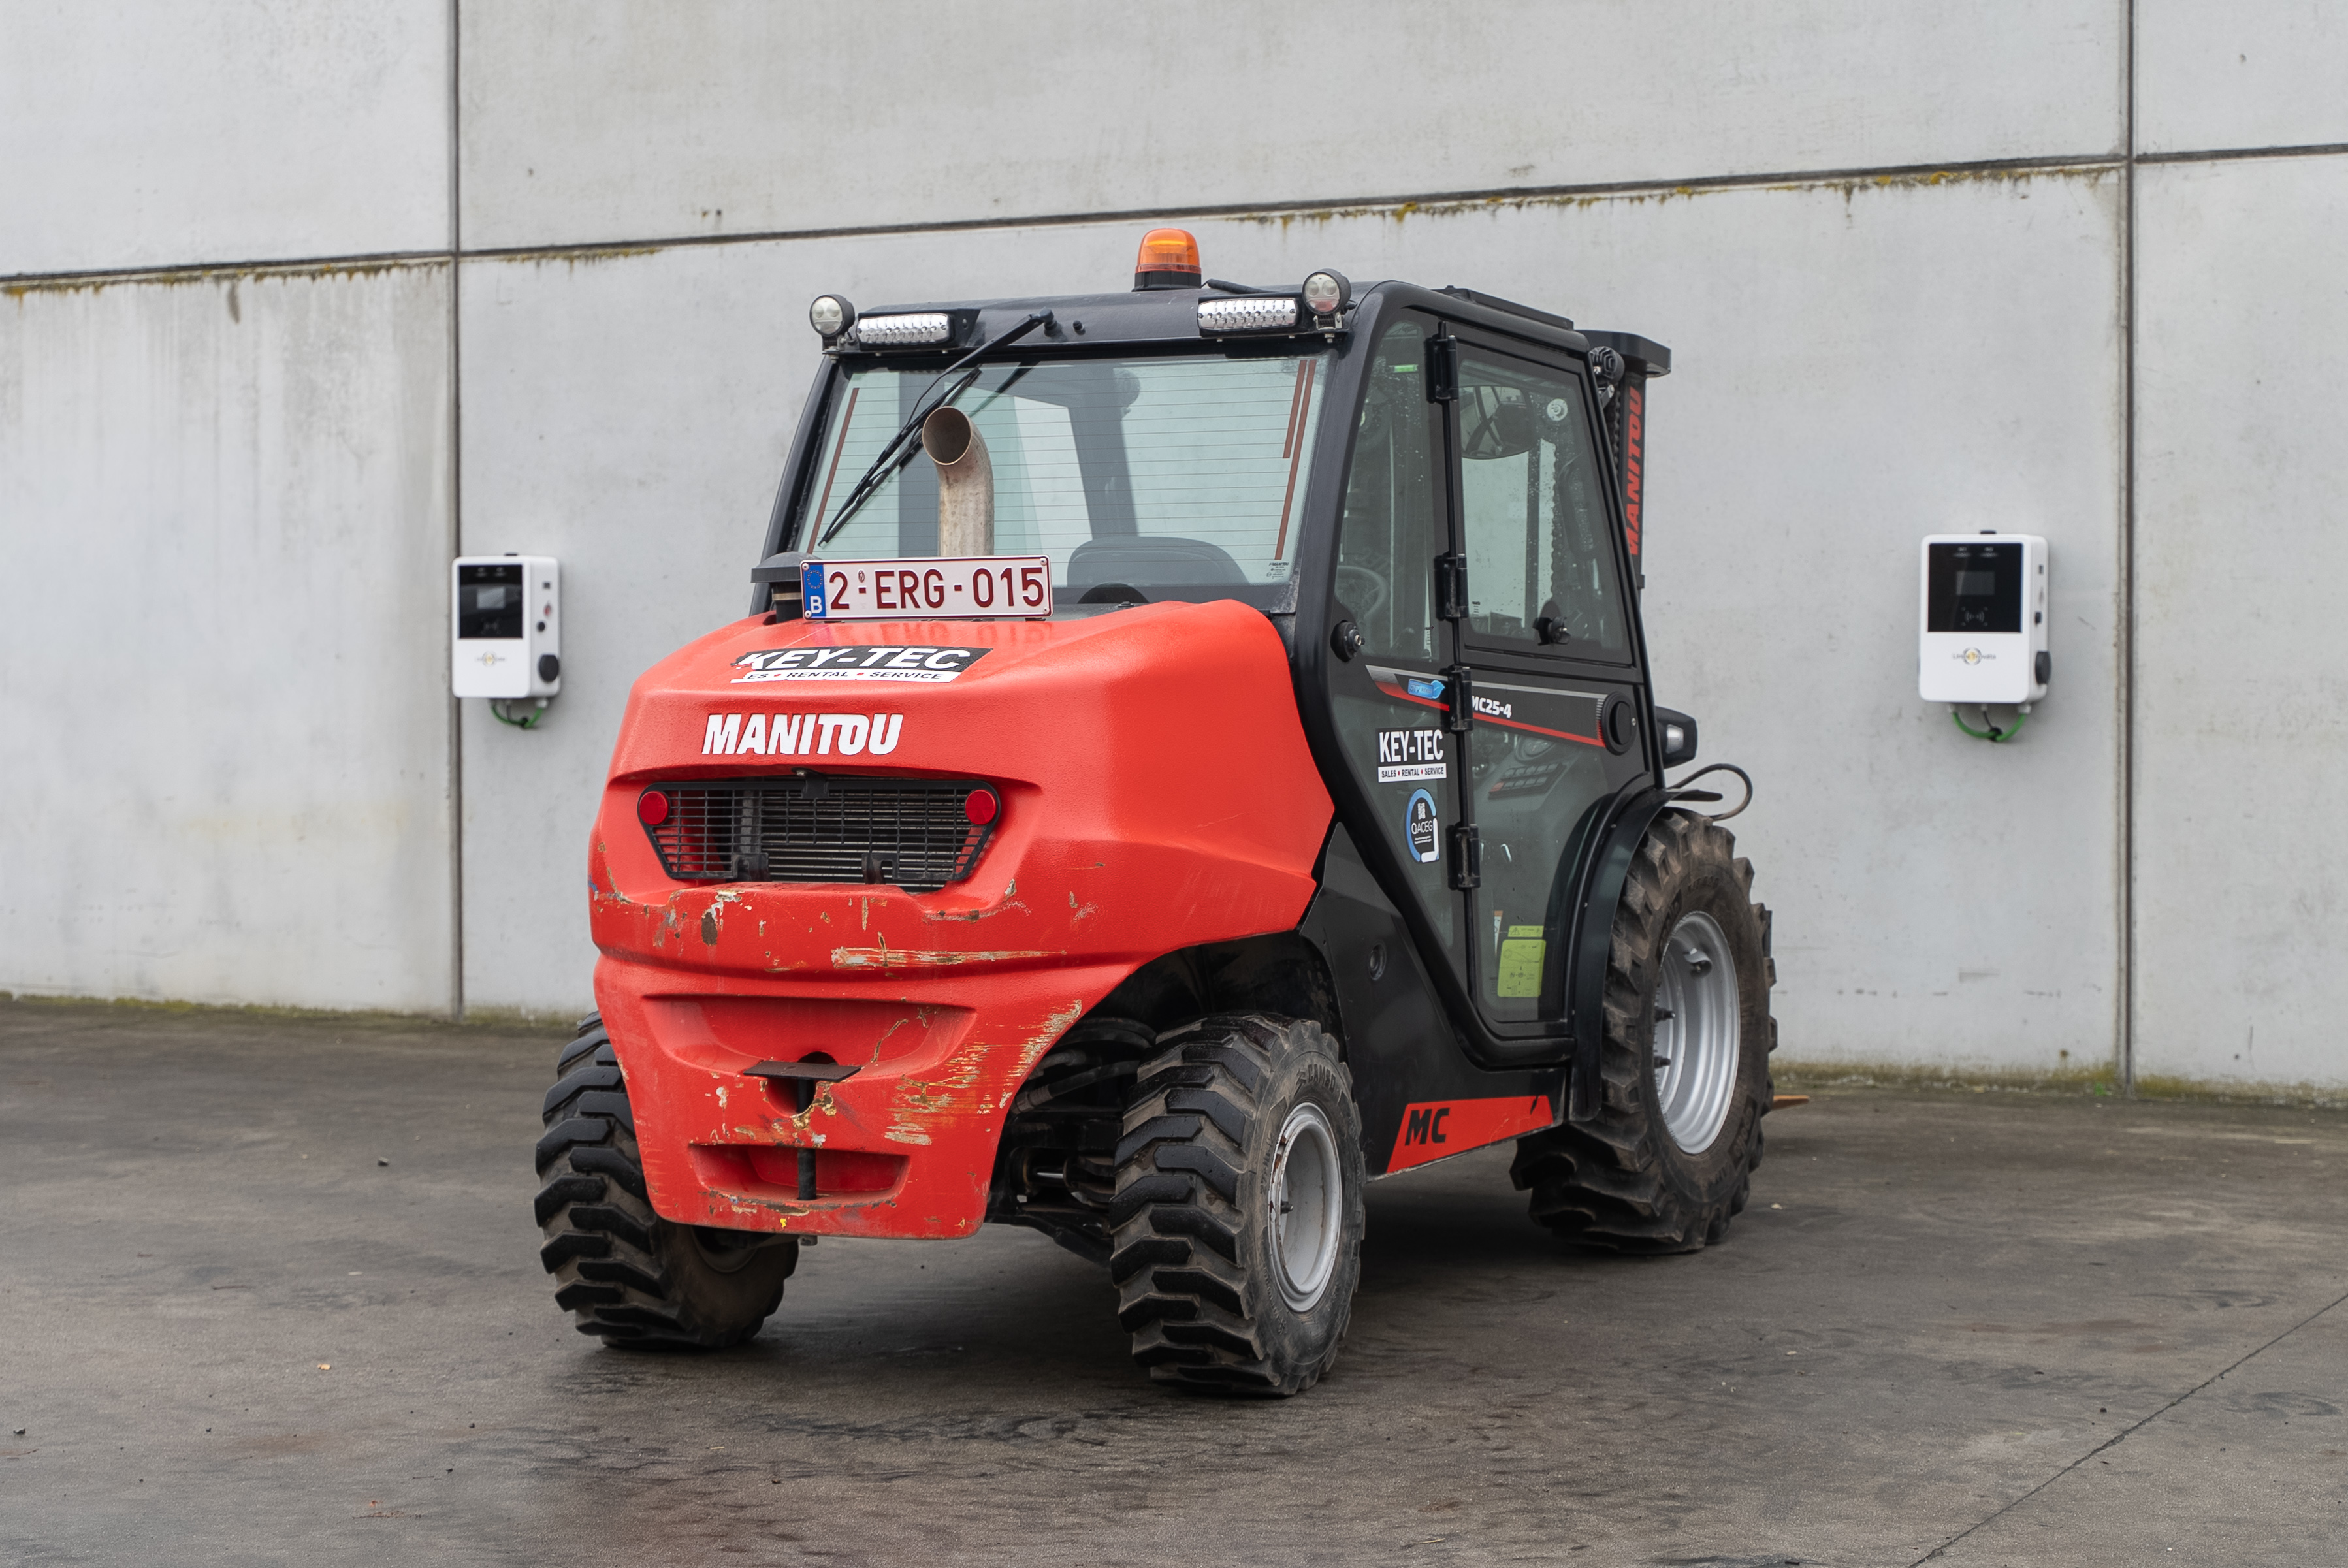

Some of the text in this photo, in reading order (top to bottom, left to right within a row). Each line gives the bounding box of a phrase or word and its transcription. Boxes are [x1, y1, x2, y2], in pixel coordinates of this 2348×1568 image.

[1626, 386, 1642, 555] MANITOU
[811, 596, 822, 613] B
[737, 648, 971, 670] KEY-TEC
[869, 671, 944, 680] SERVICE
[701, 714, 904, 756] MANITOU
[1379, 729, 1444, 763] KEY-TEC
[1381, 767, 1444, 778] SALES RENTAL SERVICE
[1405, 1108, 1450, 1146] MC
